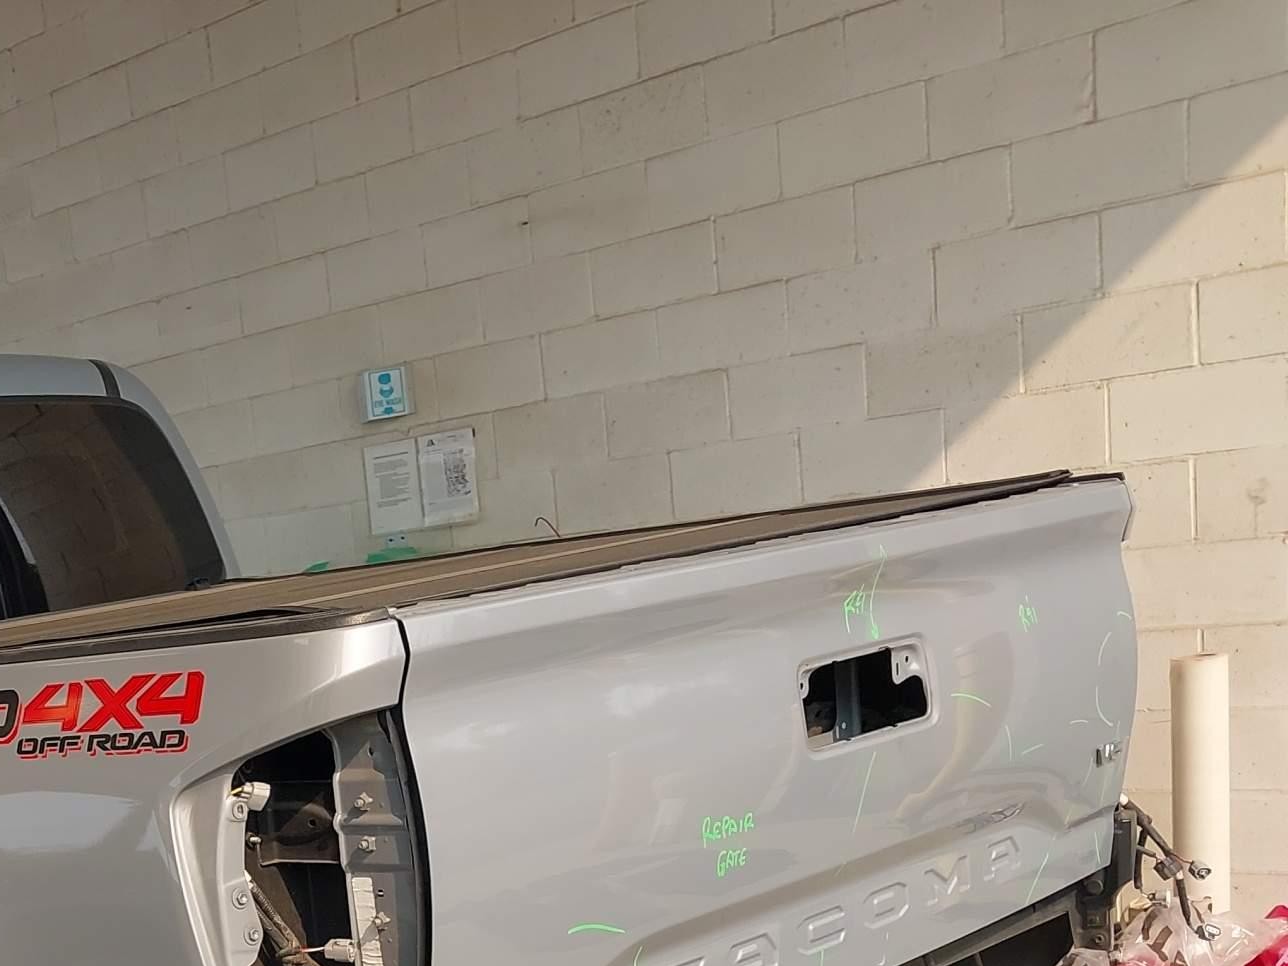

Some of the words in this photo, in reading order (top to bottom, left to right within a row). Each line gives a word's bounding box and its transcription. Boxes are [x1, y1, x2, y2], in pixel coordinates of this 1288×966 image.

[16, 734, 84, 760] OFF
[85, 729, 190, 757] ROAD
[702, 812, 755, 848] REPAIR
[716, 848, 747, 877] GATE
